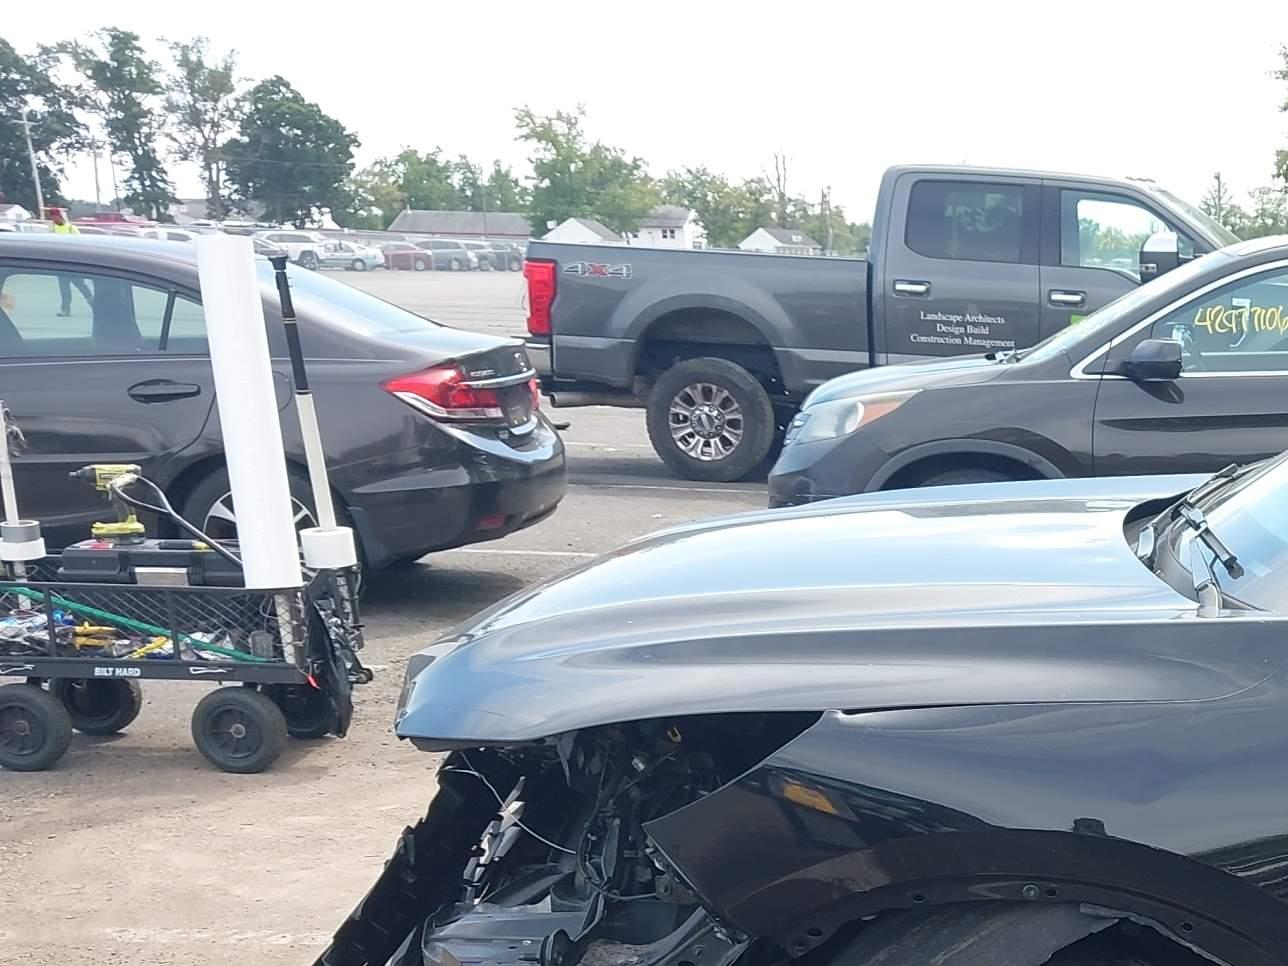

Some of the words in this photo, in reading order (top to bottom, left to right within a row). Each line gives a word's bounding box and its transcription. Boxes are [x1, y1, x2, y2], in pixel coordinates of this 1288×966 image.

[920, 311, 963, 323] Landscape
[964, 313, 1005, 324] Architects
[936, 323, 965, 335] Design
[967, 325, 990, 335] Build
[910, 333, 962, 345] Construction
[963, 336, 1015, 348] Management
[94, 667, 114, 677] BILT
[115, 667, 141, 677] HARD
